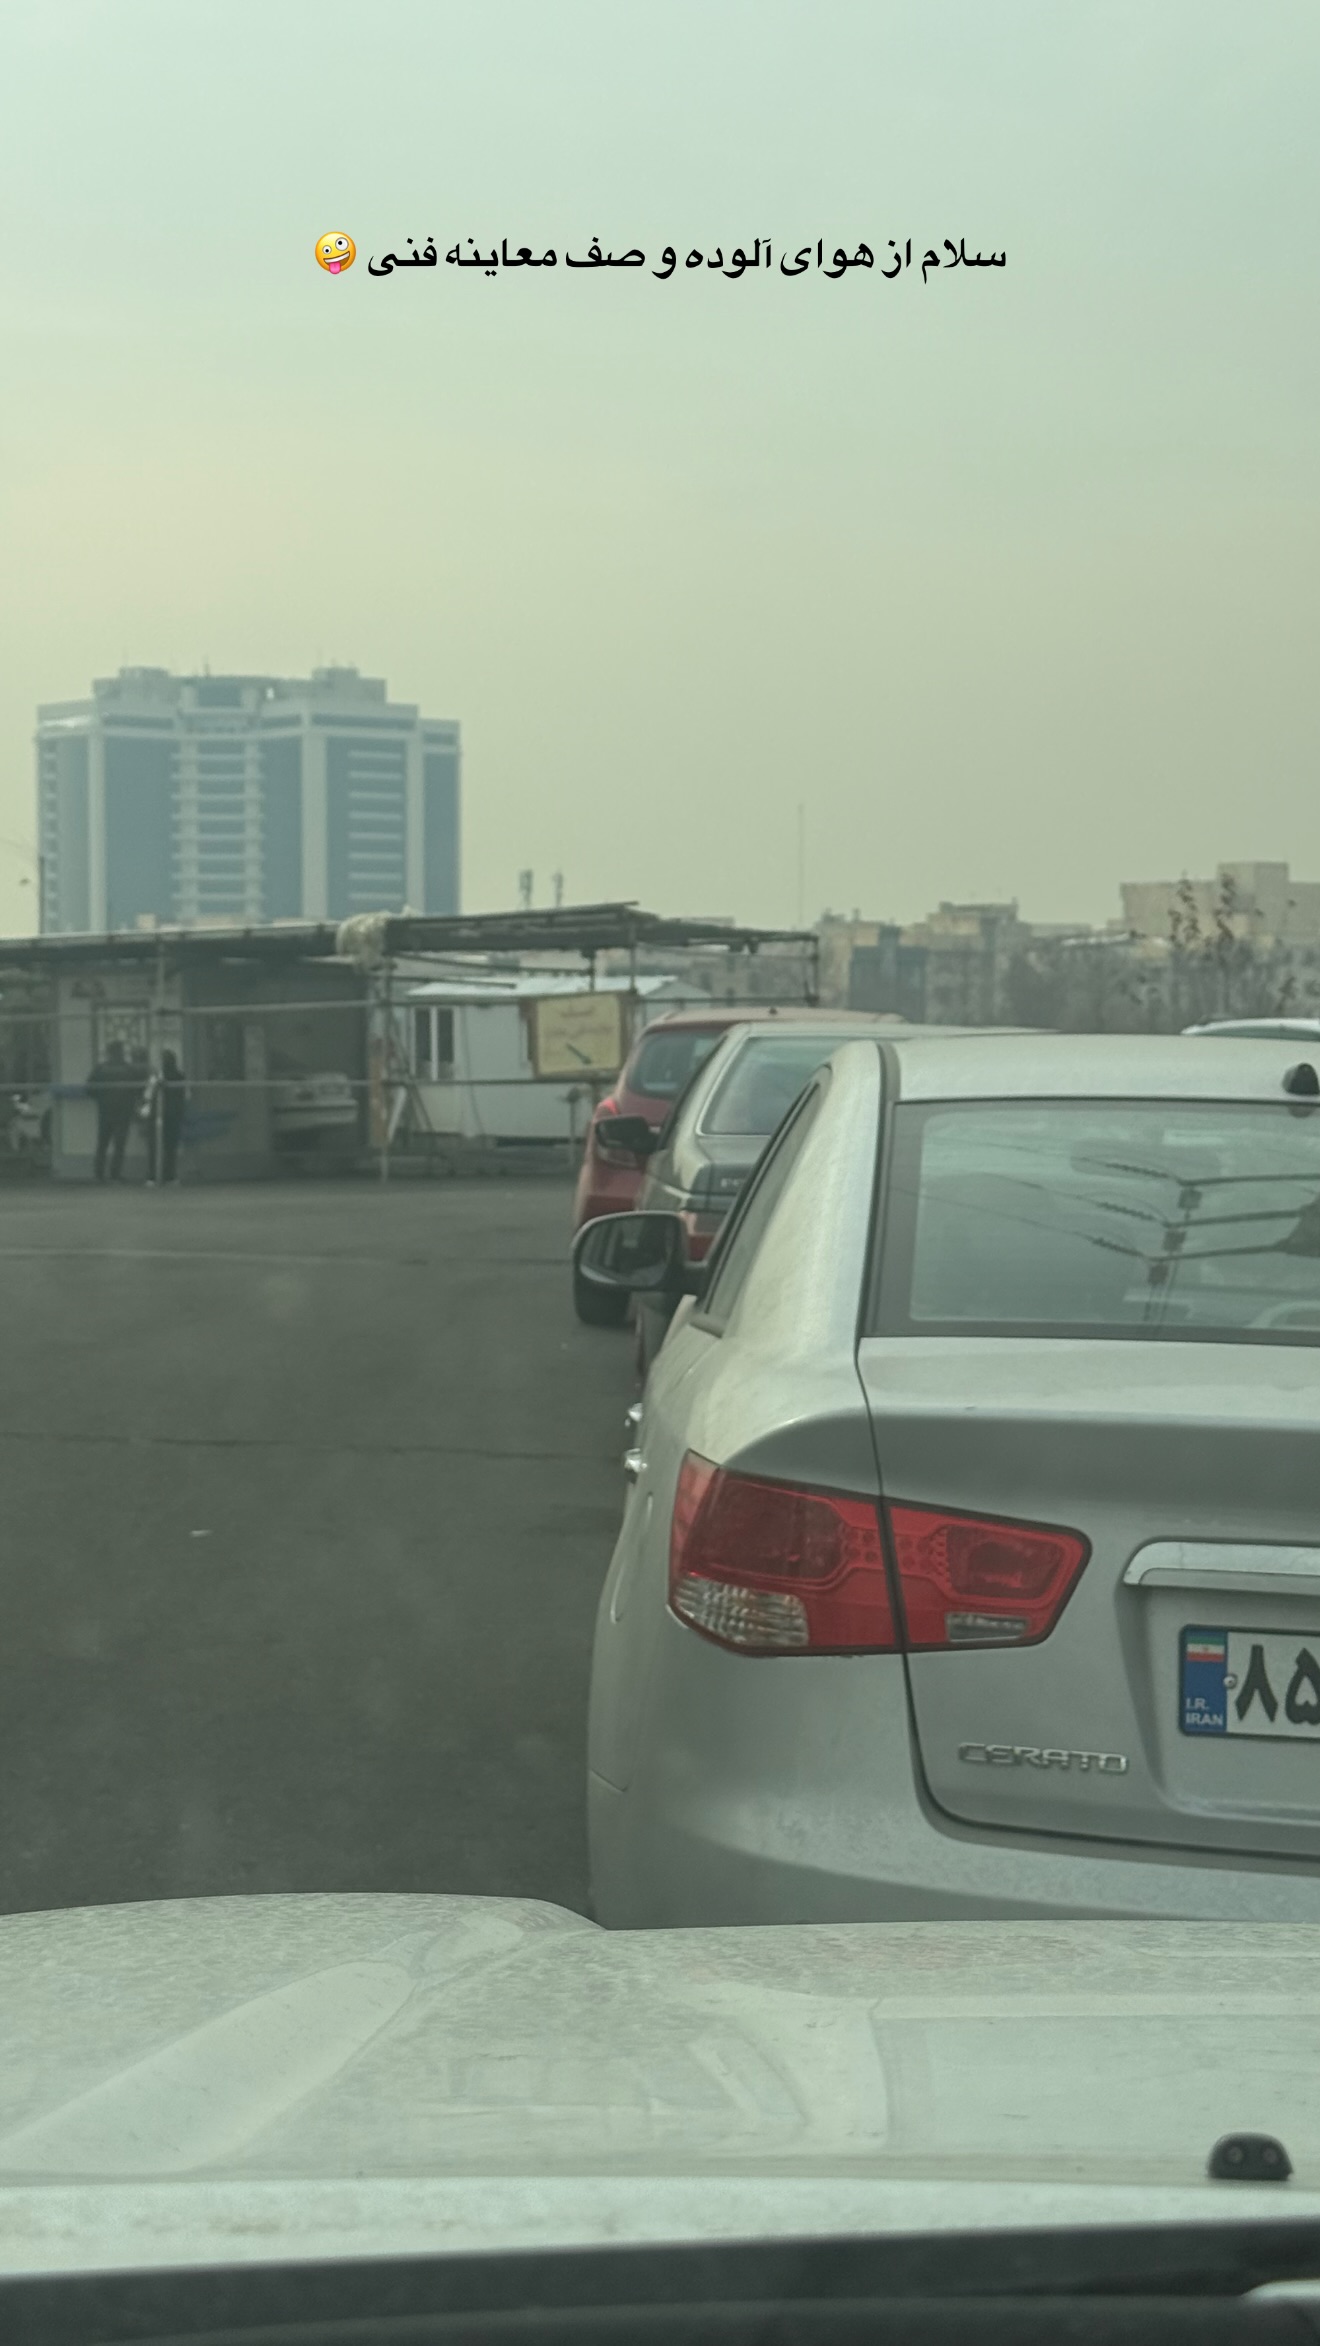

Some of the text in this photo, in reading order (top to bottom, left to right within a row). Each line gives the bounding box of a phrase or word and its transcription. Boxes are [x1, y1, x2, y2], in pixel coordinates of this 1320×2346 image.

[1185, 1697, 1210, 1711] I.R.
[1185, 1711, 1224, 1726] IRAN
[958, 1741, 1129, 1775] CERATO
